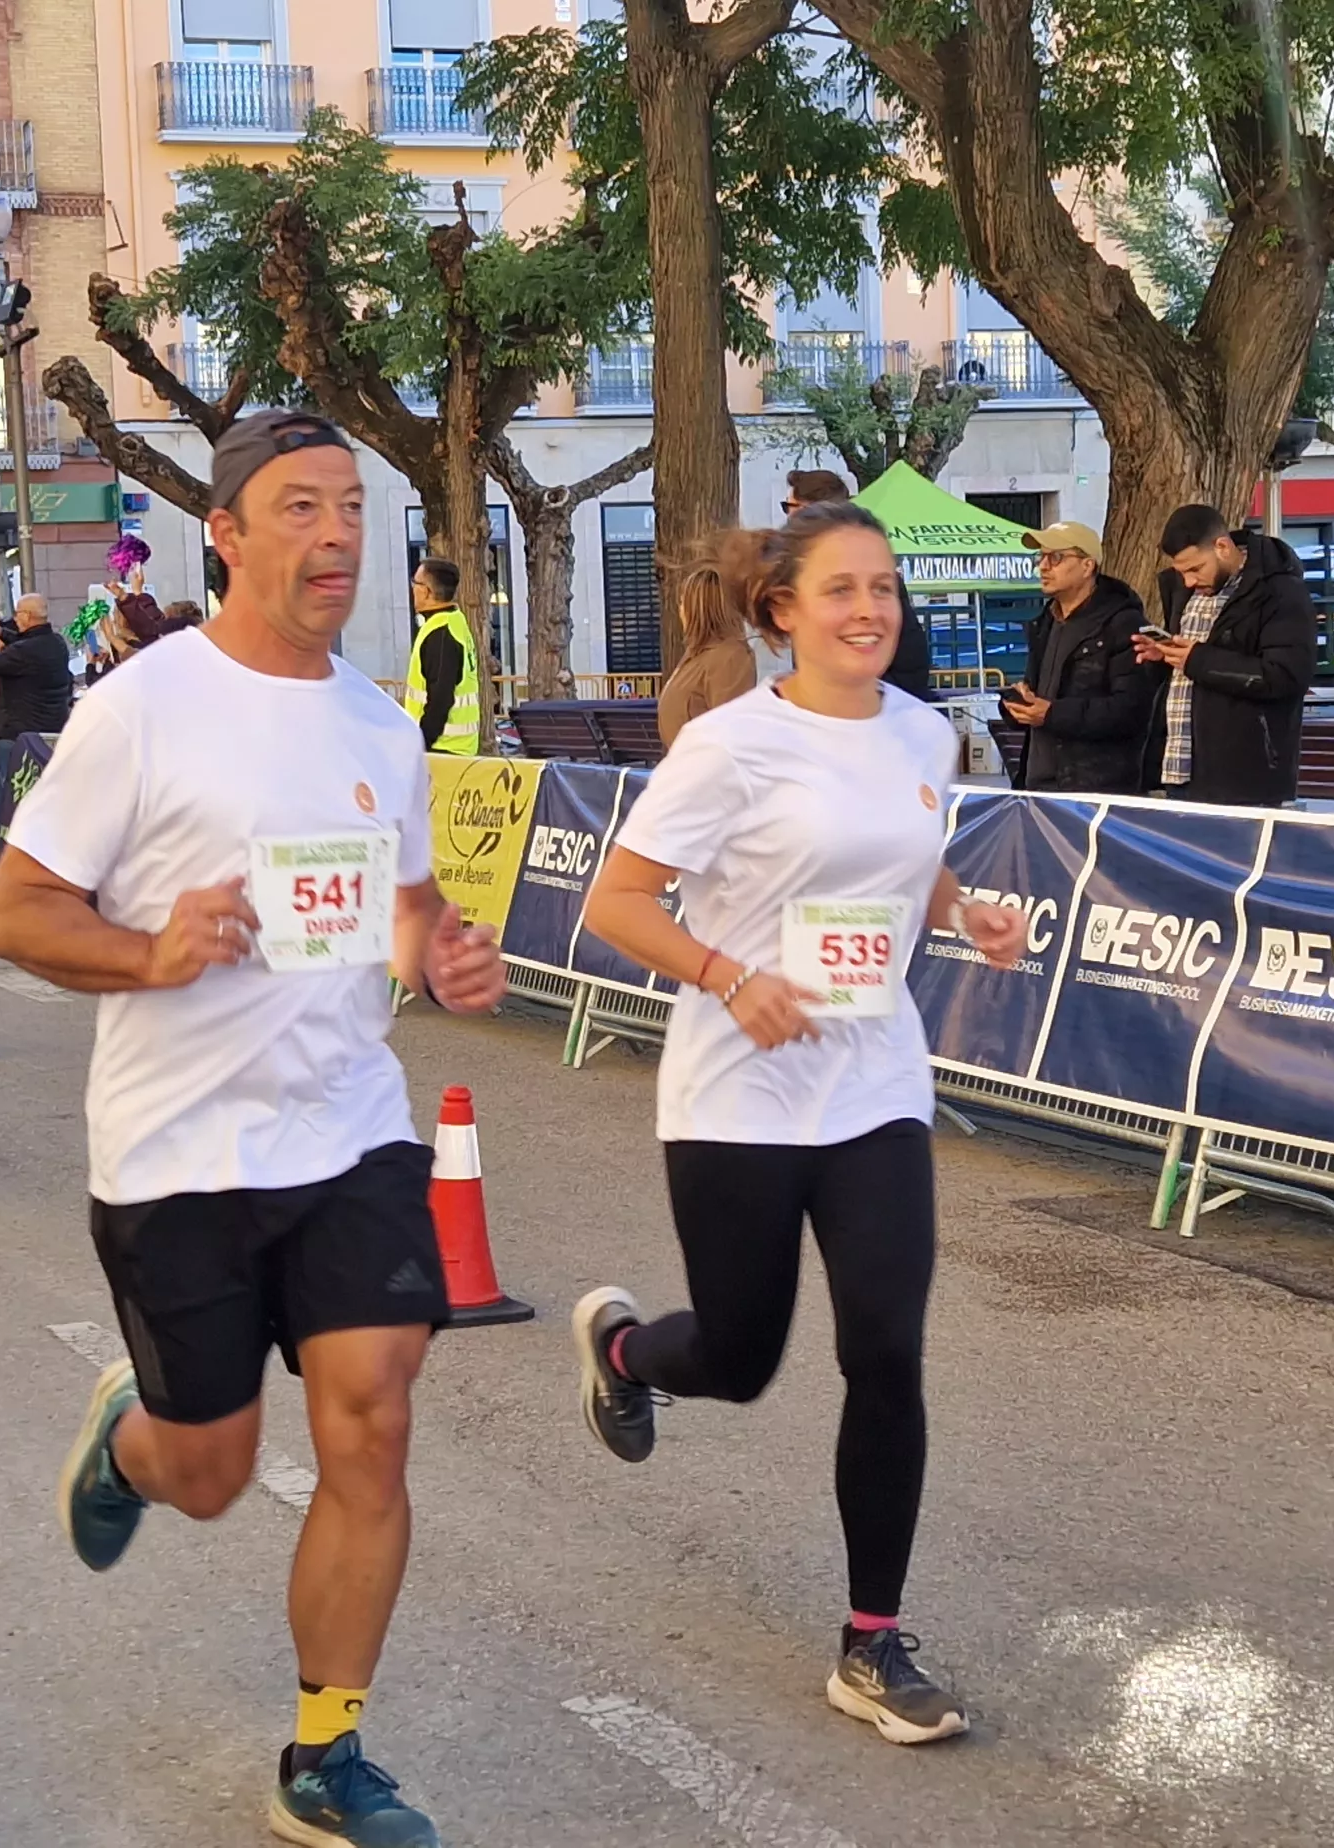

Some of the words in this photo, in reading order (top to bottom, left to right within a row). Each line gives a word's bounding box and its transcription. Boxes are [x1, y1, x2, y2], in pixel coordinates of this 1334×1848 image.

[1009, 477, 1018, 491] 2
[908, 525, 1001, 534] FARTLECK
[922, 536, 1008, 546] SPORT
[914, 556, 1033, 581] AVITUALLAMIENTO
[544, 828, 596, 876] ESIC
[292, 871, 364, 914] 541
[304, 915, 359, 936] DIEGO
[819, 932, 891, 967] 539
[1109, 908, 1221, 979] ESIC
[1075, 968, 1200, 1002] BUSINESS&MARKETINGSCHOOL
